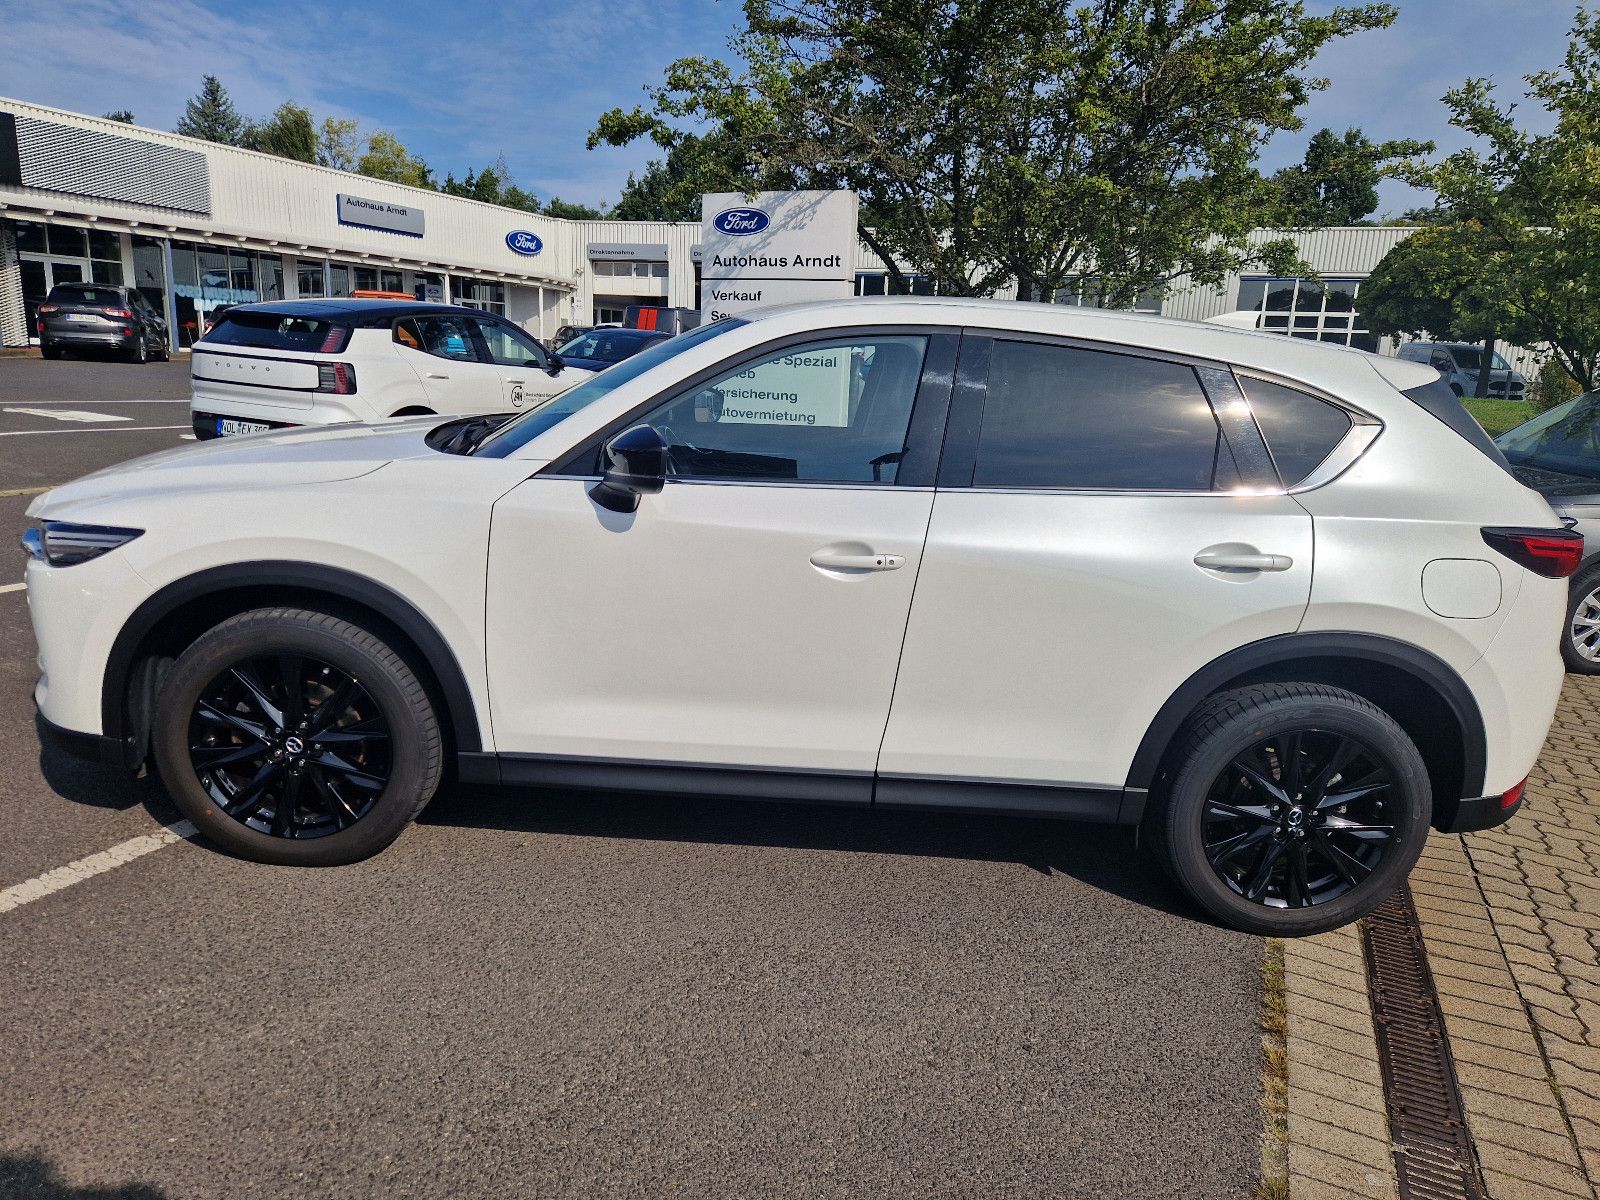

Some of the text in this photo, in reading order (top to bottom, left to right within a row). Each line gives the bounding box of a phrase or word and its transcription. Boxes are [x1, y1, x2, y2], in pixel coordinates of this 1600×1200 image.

[346, 197, 408, 217] Autohaus Arndt
[712, 254, 841, 268] Autohaus Arndt
[711, 290, 762, 301] Verkauf
[215, 361, 271, 372] VOLVO
[783, 355, 837, 368] Spezial
[716, 387, 798, 404] ersicherung
